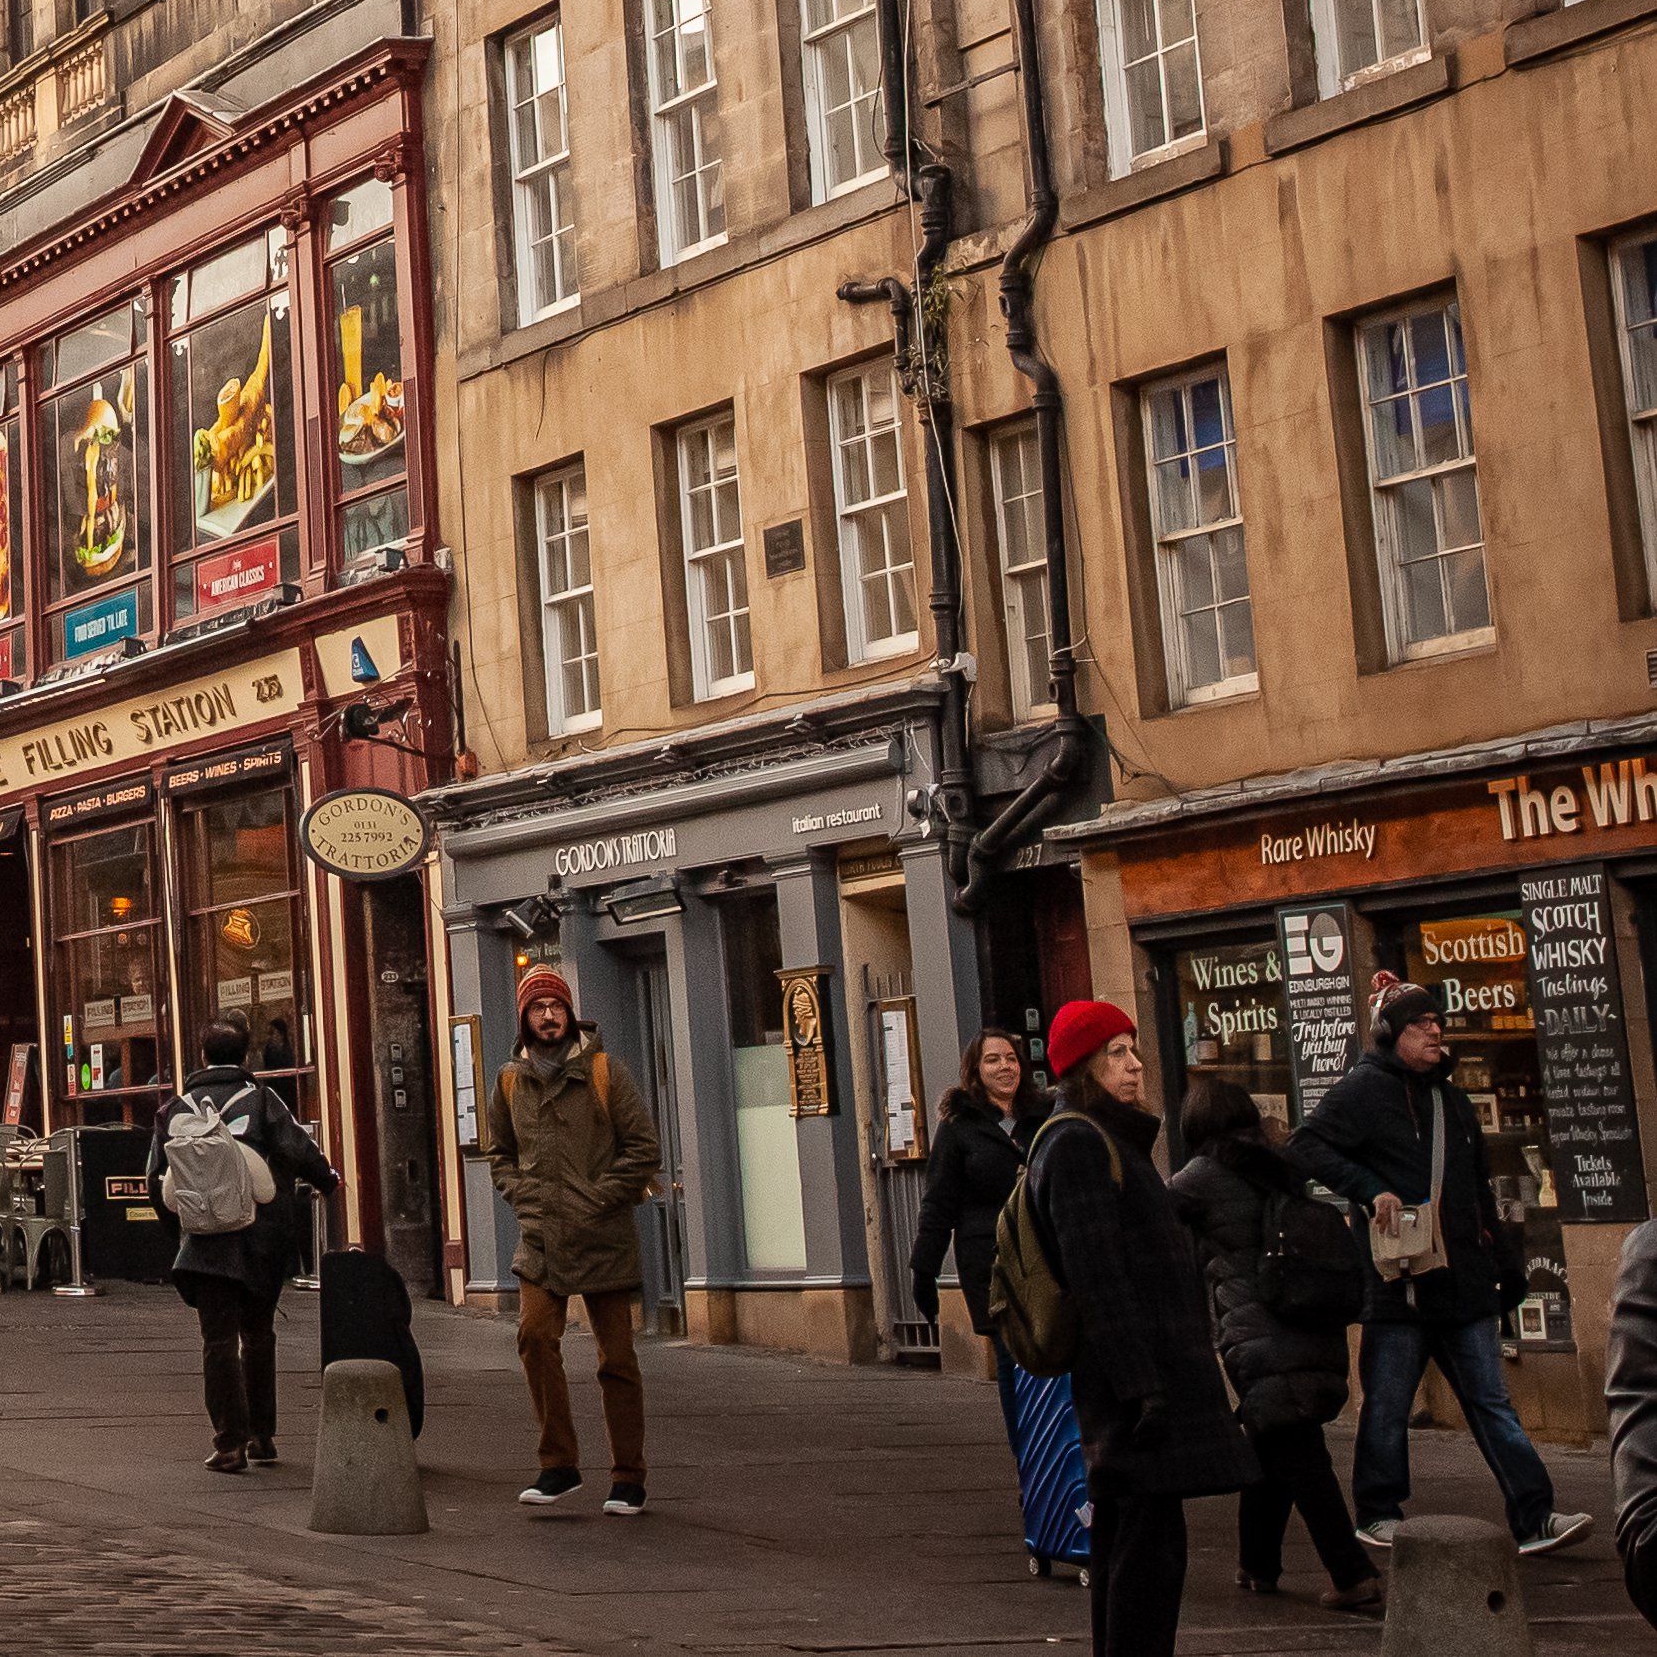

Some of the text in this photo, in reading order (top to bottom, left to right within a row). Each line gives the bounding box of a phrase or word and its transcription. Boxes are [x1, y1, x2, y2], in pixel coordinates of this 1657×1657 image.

[211, 564, 265, 597] AMERICAN CLASSICS
[21, 721, 114, 776] FILLING
[130, 681, 237, 744] STATION
[169, 750, 282, 789] BEERS WINES SPIRITS
[49, 785, 146, 821] PIZZA PASTA BURGERS
[318, 797, 411, 826] GORDON'S
[791, 802, 882, 834] italian restaurant
[1488, 775, 1581, 840] The
[341, 832, 393, 843] 225 7992
[353, 821, 377, 830] 0131
[1261, 817, 1376, 865] Rare Whisky
[316, 835, 419, 870] TRATTORIA
[621, 827, 677, 864] TRATTORIA
[1016, 843, 1042, 869] 227
[1522, 874, 1602, 901] SINGLE MALT
[1531, 902, 1601, 942] SCOTCH
[1424, 920, 1526, 965] Scottish
[1532, 937, 1607, 970] WHISKY
[1190, 950, 1283, 991] Wines &
[1288, 975, 1350, 993] EDINBURGH GIN
[1537, 973, 1608, 1000] Tastings
[1442, 977, 1516, 1014] Beers
[1208, 998, 1278, 1046] Spirits
[1299, 1007, 1323, 1020] LOCALLY
[1324, 1005, 1352, 1017] DISTILLED
[1544, 1004, 1610, 1036] DAILY
[1291, 1017, 1356, 1042] Try before
[1301, 1035, 1346, 1060] you buy
[1312, 1053, 1347, 1073] here!
[1574, 1154, 1612, 1172] Tickets
[1572, 1171, 1622, 1188] Available
[1582, 1190, 1613, 1207] Inside
